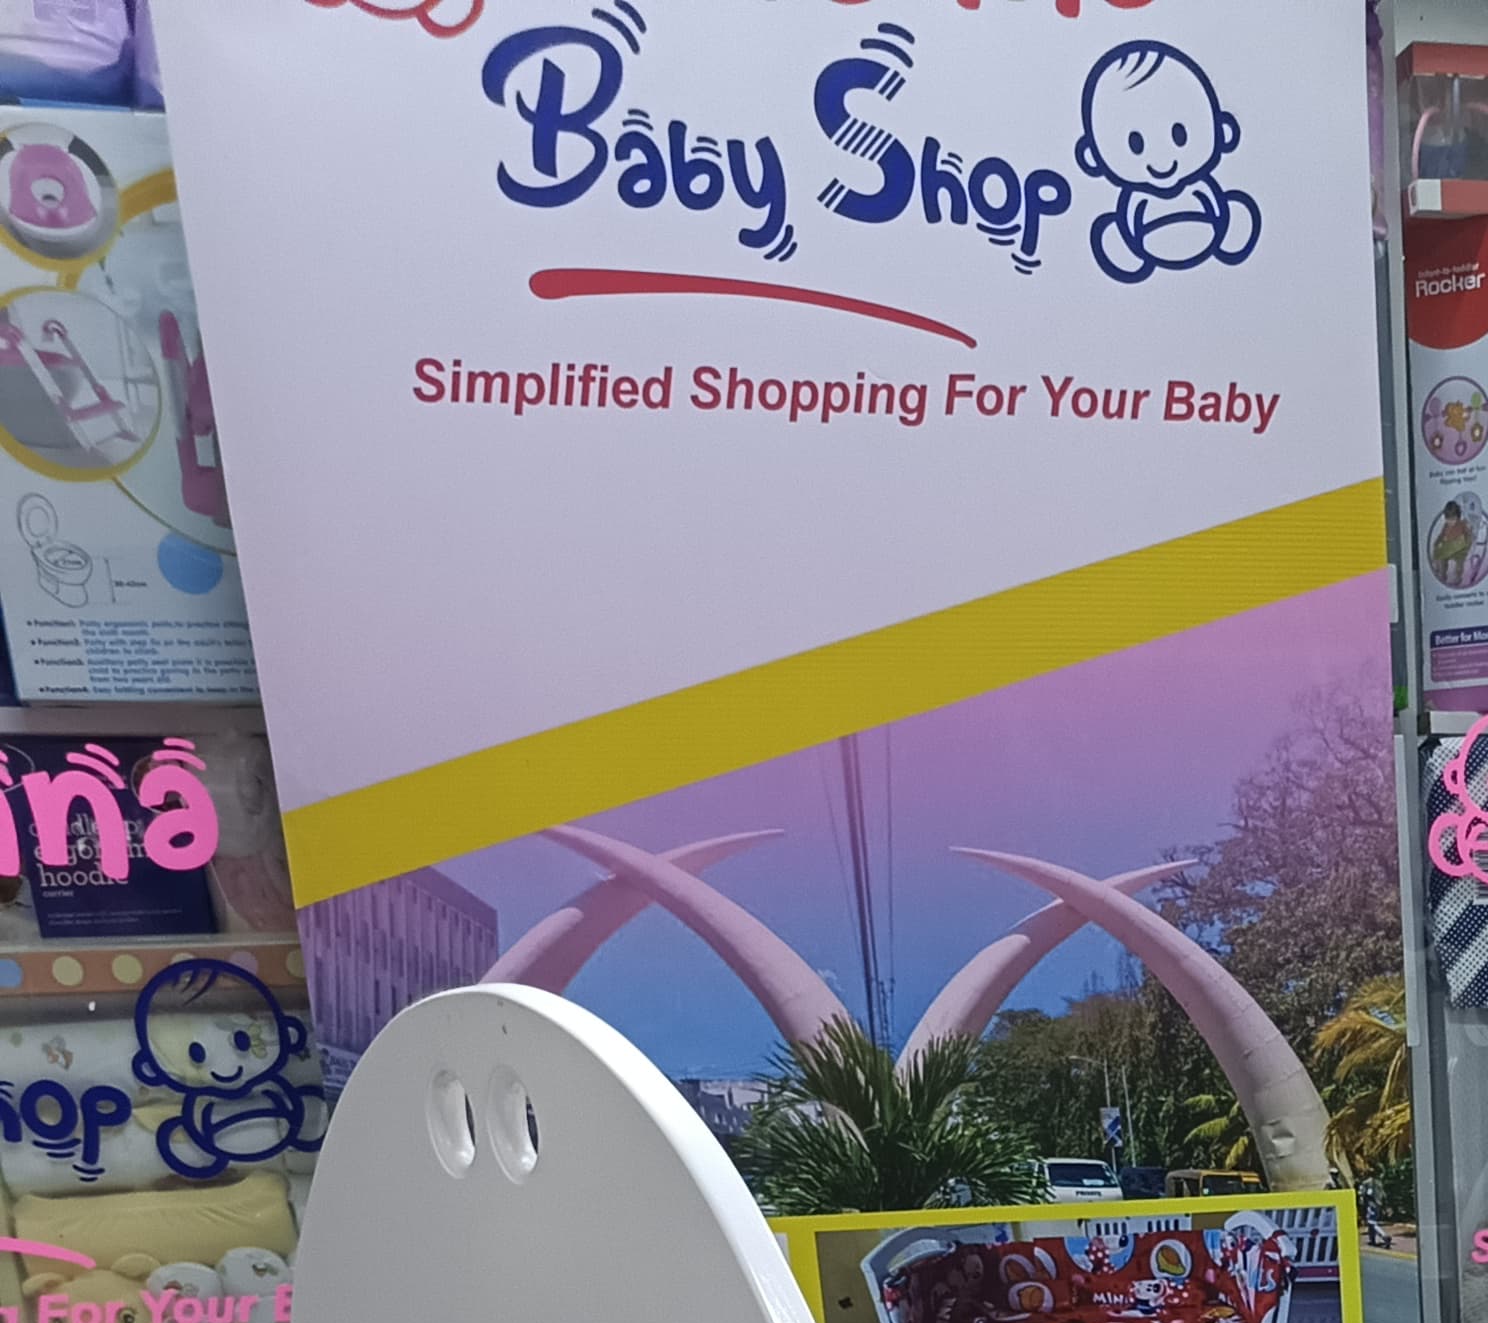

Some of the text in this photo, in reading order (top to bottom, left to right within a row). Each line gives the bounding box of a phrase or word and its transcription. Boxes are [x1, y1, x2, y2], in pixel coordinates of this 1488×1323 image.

[482, 26, 1071, 255] Baby Shop
[1416, 272, 1486, 298] Rocker
[413, 358, 1280, 434] Simplified Shopping For Your Baby
